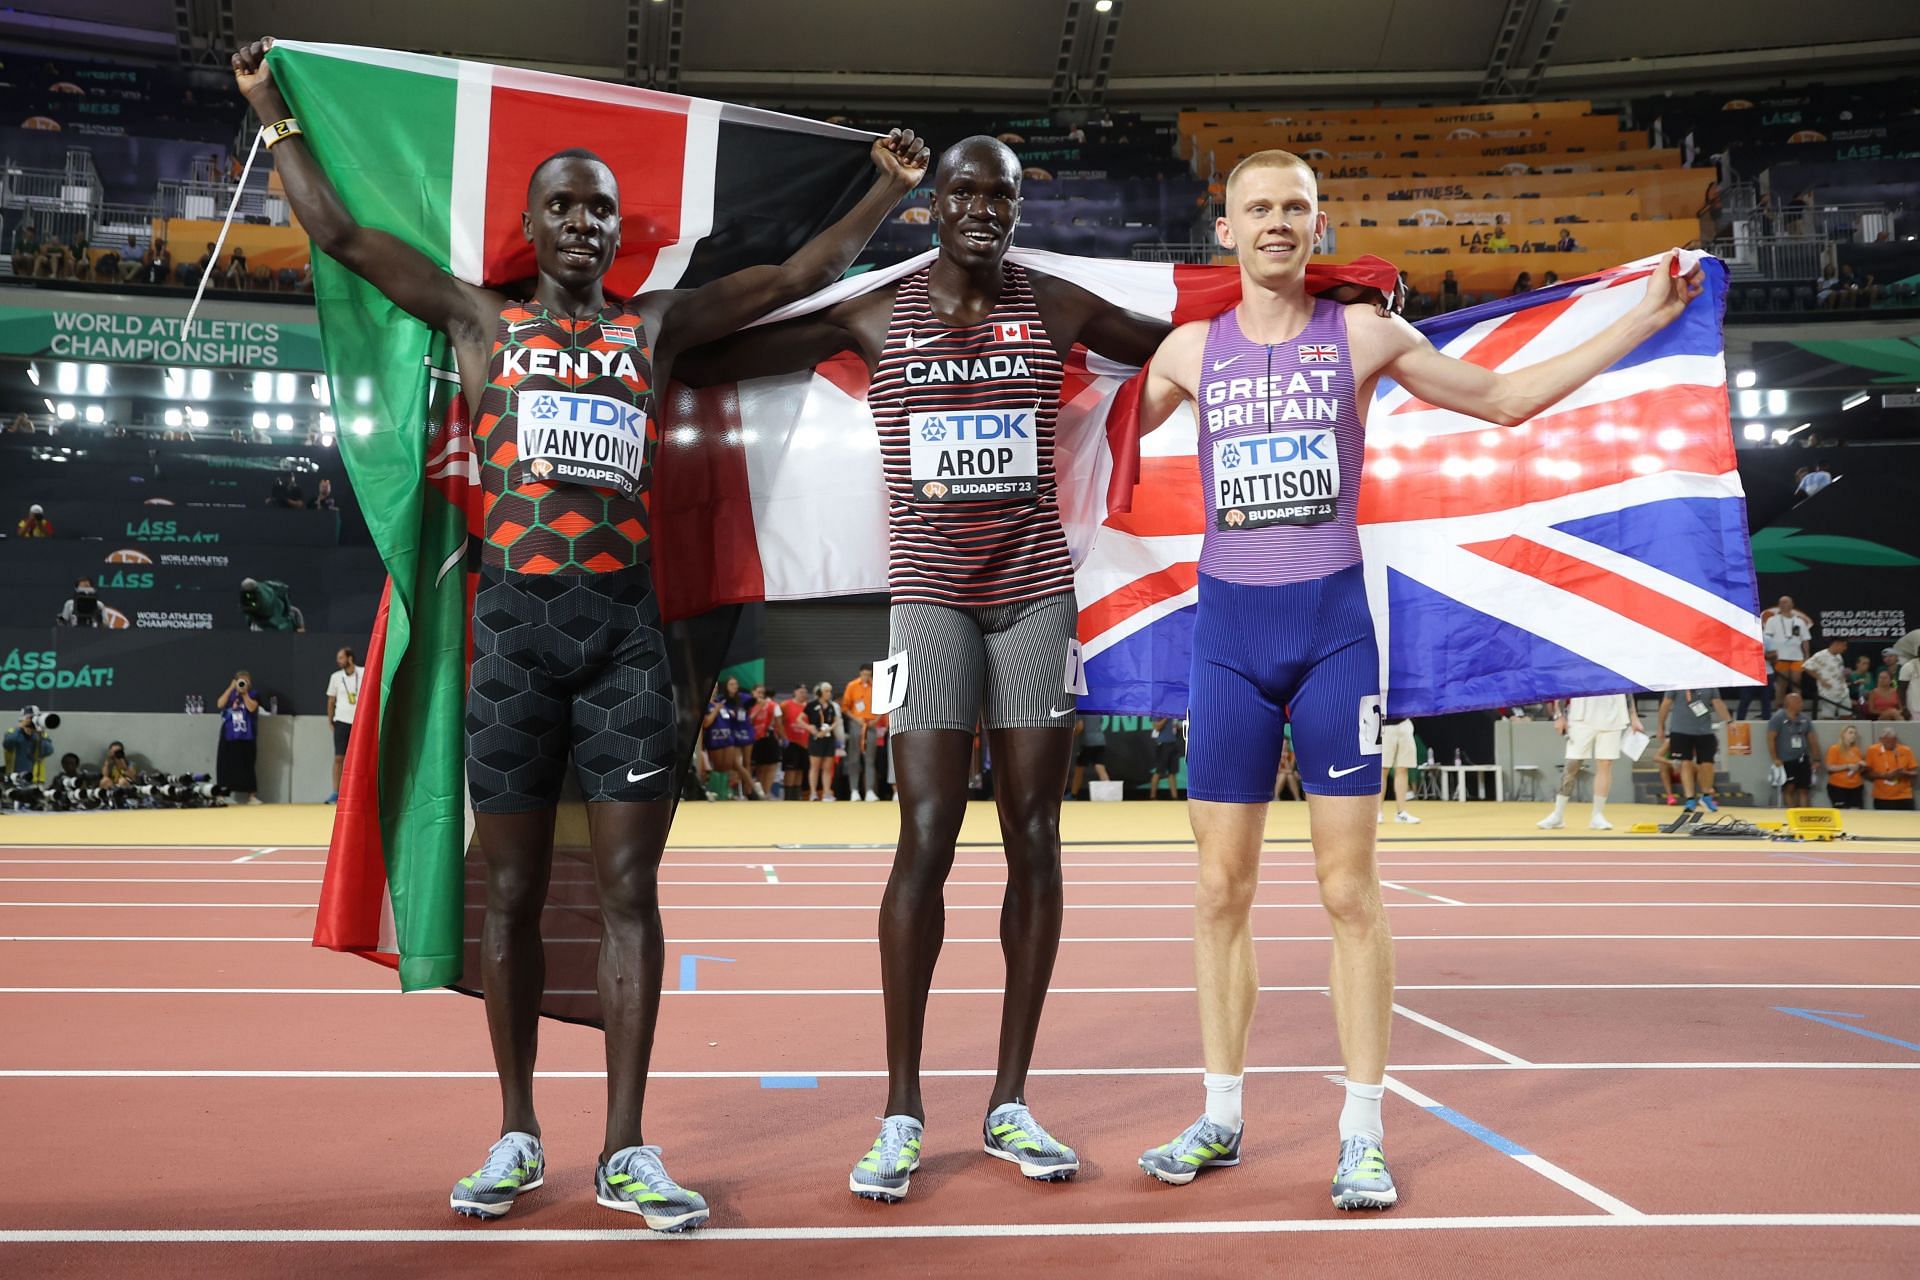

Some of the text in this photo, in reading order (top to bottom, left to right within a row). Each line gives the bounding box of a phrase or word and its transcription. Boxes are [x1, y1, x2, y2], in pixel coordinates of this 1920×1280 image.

[53, 311, 280, 342] WORLD ATHLETICS
[51, 333, 279, 366] CHAMPIONSHIPS
[503, 348, 640, 383] KENYA
[905, 355, 1031, 384] CANADA
[1206, 370, 1337, 406] GREAT
[560, 396, 643, 439] TDK
[946, 413, 1029, 441] TDK
[1207, 398, 1339, 433] BRITAIN
[523, 428, 640, 482] WANYONYI
[936, 447, 1014, 477] AROP
[1240, 434, 1329, 466] TDK
[557, 463, 634, 494] BUDAPEST 23
[951, 482, 1032, 495] BUDAPEST 23
[1220, 468, 1333, 507] PATTISON
[1248, 504, 1332, 521] BUDAPEST 23
[126, 518, 177, 536] LÁSS
[160, 554, 188, 563] WORLD
[189, 555, 229, 565] ATHLETICS
[98, 570, 155, 588] LÁSS
[136, 619, 213, 630] CHAMPIONSHIPS
[137, 611, 213, 622] WORLD ATHLETICS
[1821, 610, 1905, 619] WORLD ATHLETICS
[1821, 618, 1906, 627] CHAMPIONSHIPS
[1822, 627, 1906, 637] BUDAPEST 23
[0, 648, 57, 671] ÁSS
[0, 665, 114, 692] CSODÁT!
[887, 663, 899, 703] 7
